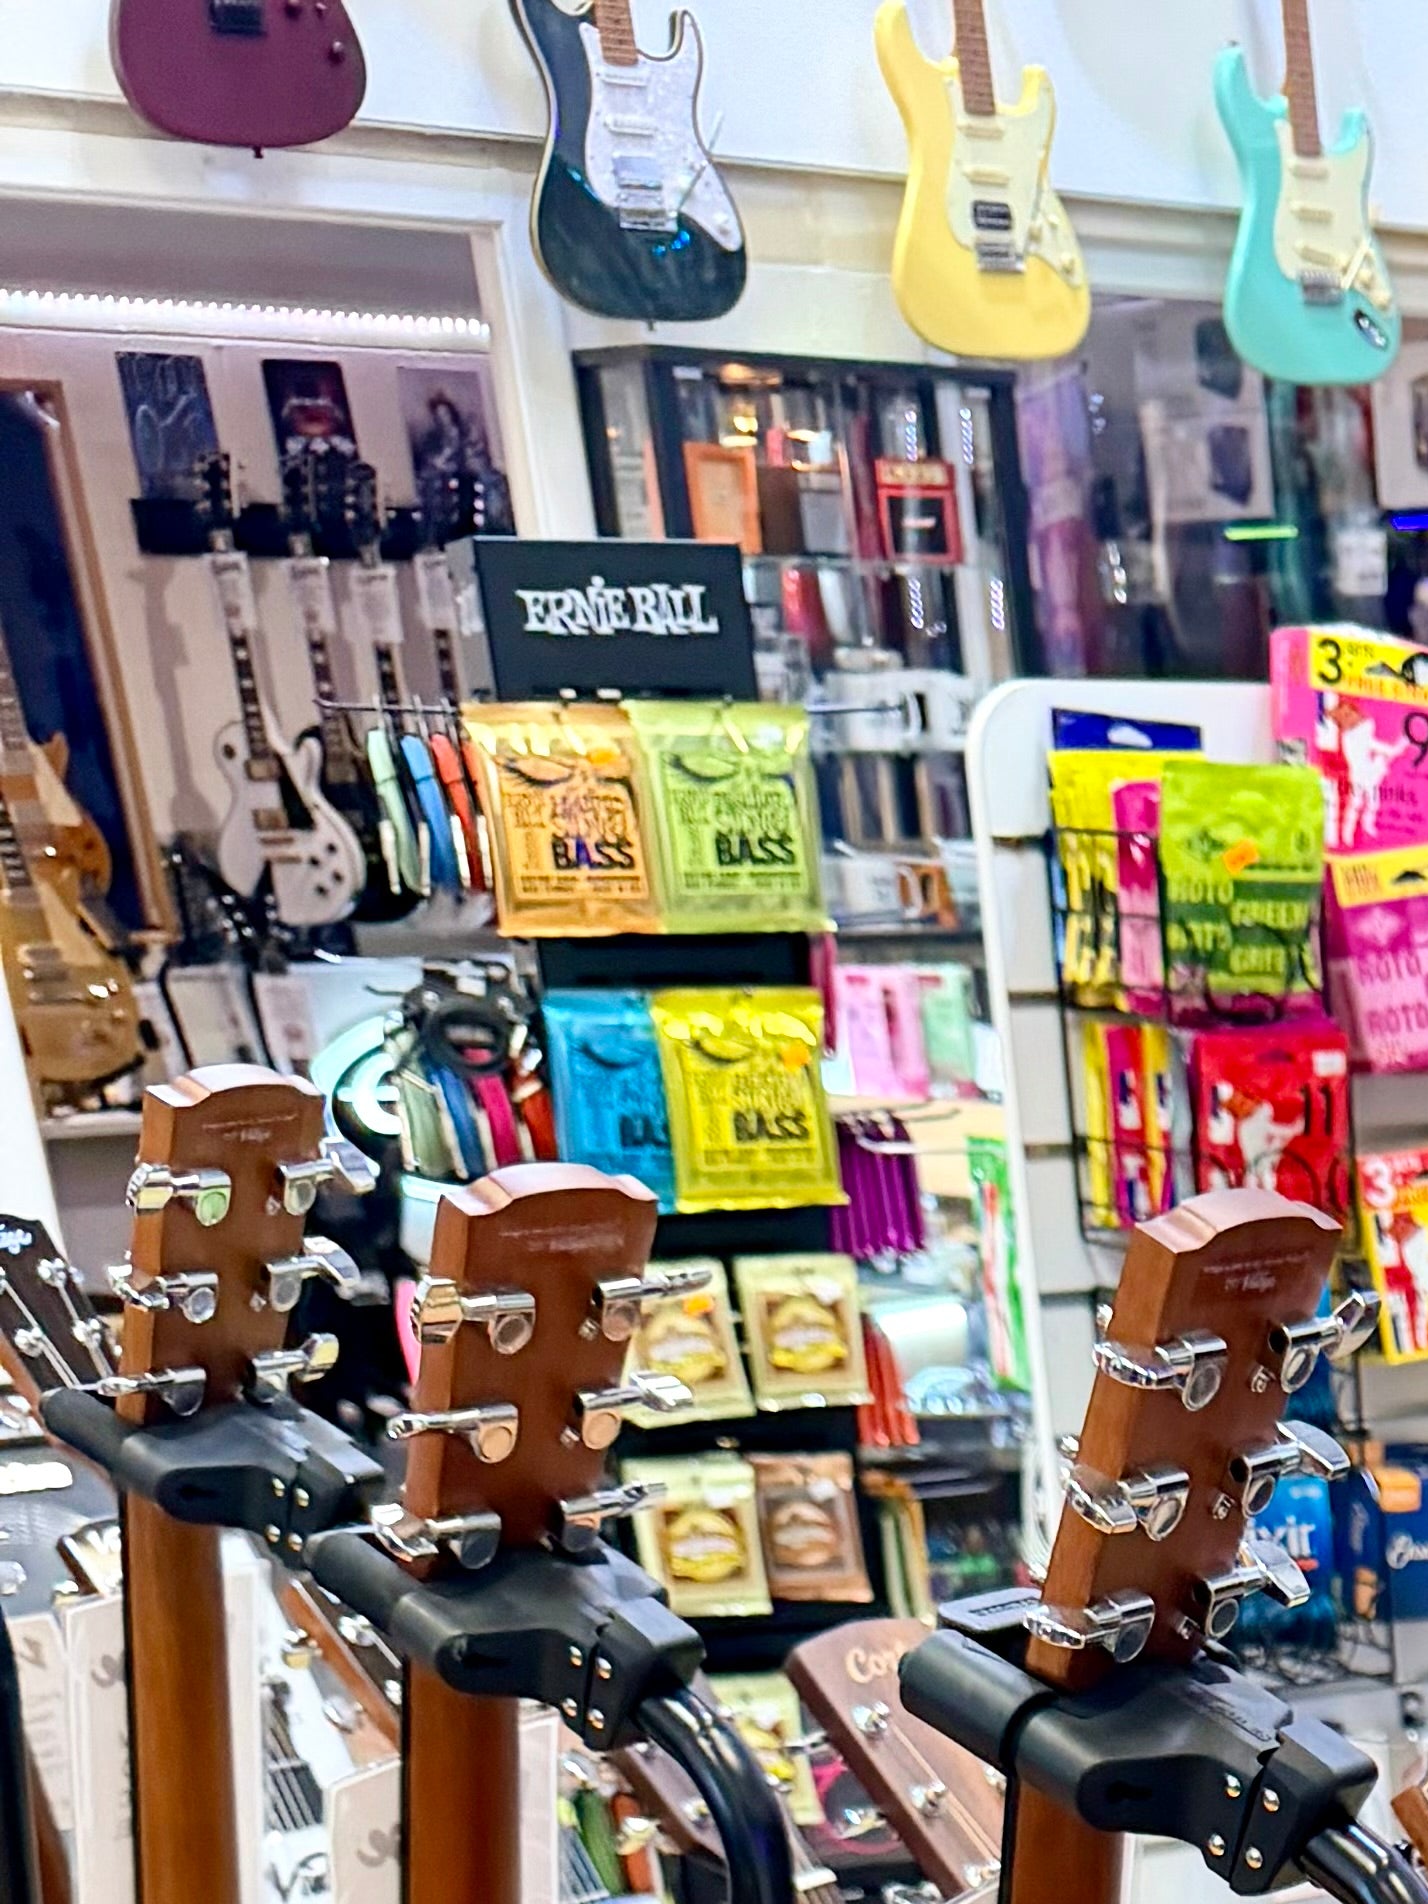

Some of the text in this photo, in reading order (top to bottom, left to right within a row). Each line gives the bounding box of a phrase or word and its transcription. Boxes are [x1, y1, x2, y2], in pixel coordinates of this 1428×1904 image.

[516, 576, 719, 635] ERNIE BALL
[1318, 638, 1341, 684] 3
[551, 833, 635, 871] BASS
[715, 829, 796, 867] BASS
[733, 1108, 809, 1142] BASS
[1302, 1082, 1332, 1136] 11
[620, 1114, 671, 1148] BA
[1365, 1160, 1395, 1207] 3
